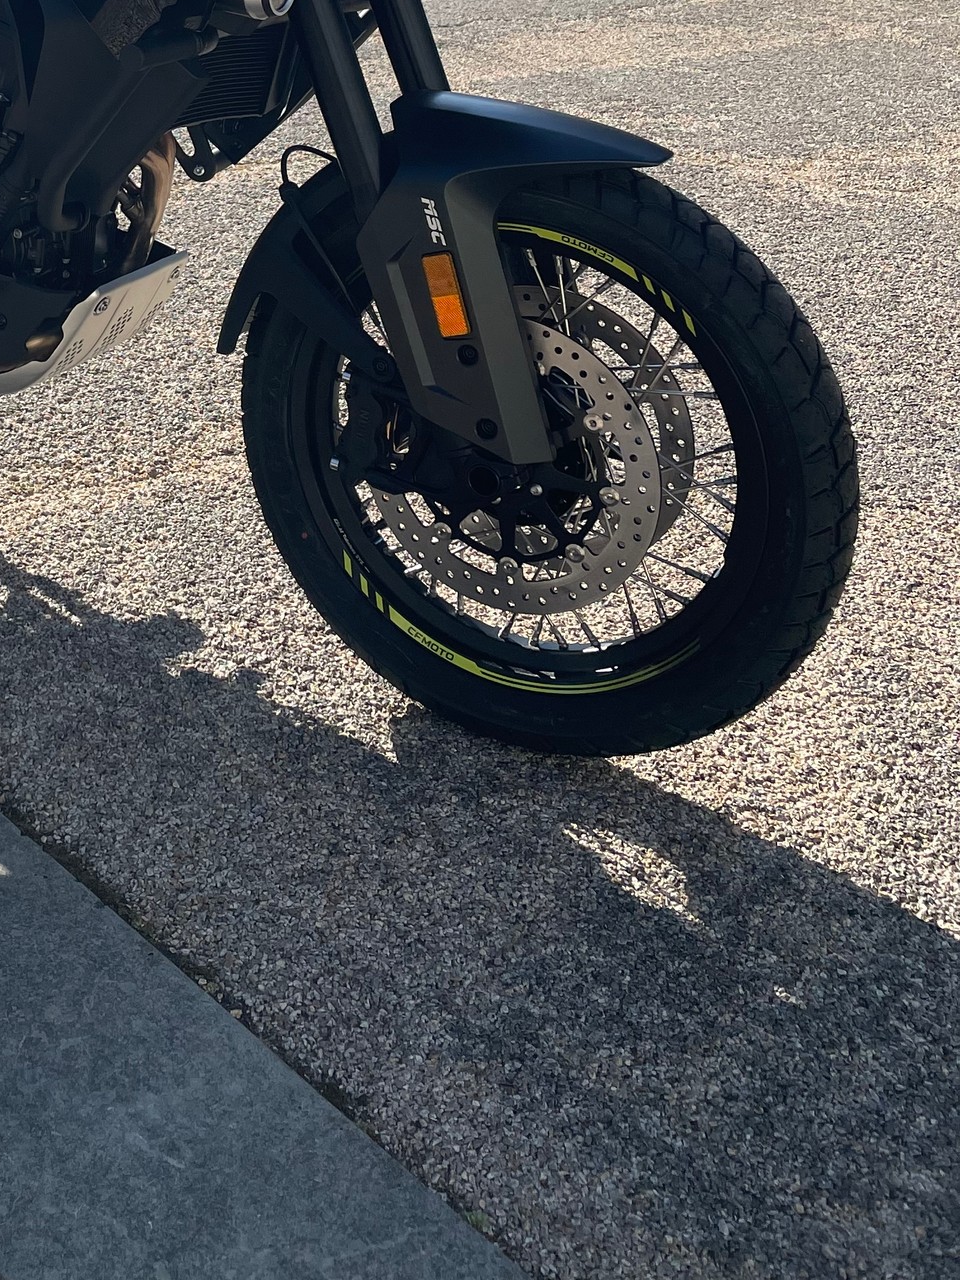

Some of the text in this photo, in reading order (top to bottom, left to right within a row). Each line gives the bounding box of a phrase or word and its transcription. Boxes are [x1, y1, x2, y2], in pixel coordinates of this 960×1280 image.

[420, 197, 447, 246] MSC
[561, 236, 615, 263] CFMOTO
[407, 626, 455, 661] CFMOTO
